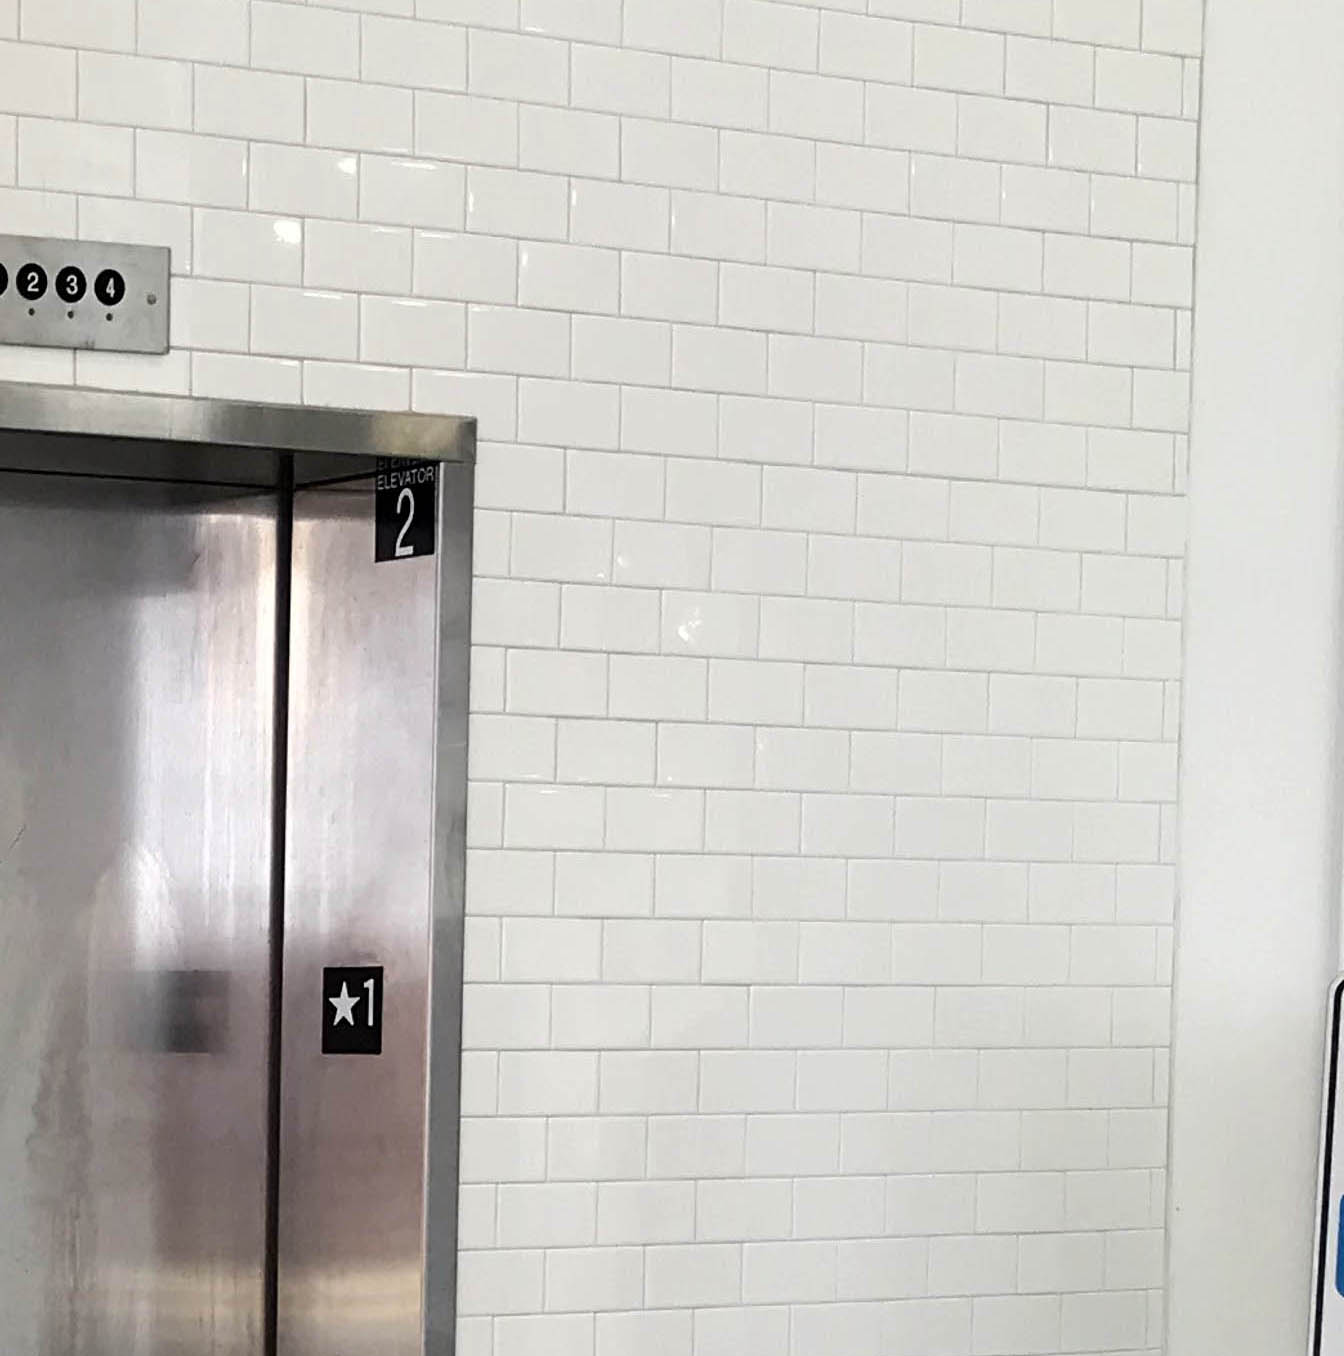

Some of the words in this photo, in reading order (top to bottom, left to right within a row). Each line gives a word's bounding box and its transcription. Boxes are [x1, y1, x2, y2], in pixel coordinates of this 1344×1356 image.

[27, 272, 39, 292] 2
[66, 275, 78, 295] 3
[105, 278, 116, 298] 4
[377, 466, 434, 490] ELEVATOR
[395, 488, 415, 557] 2
[363, 978, 374, 1027] 1
